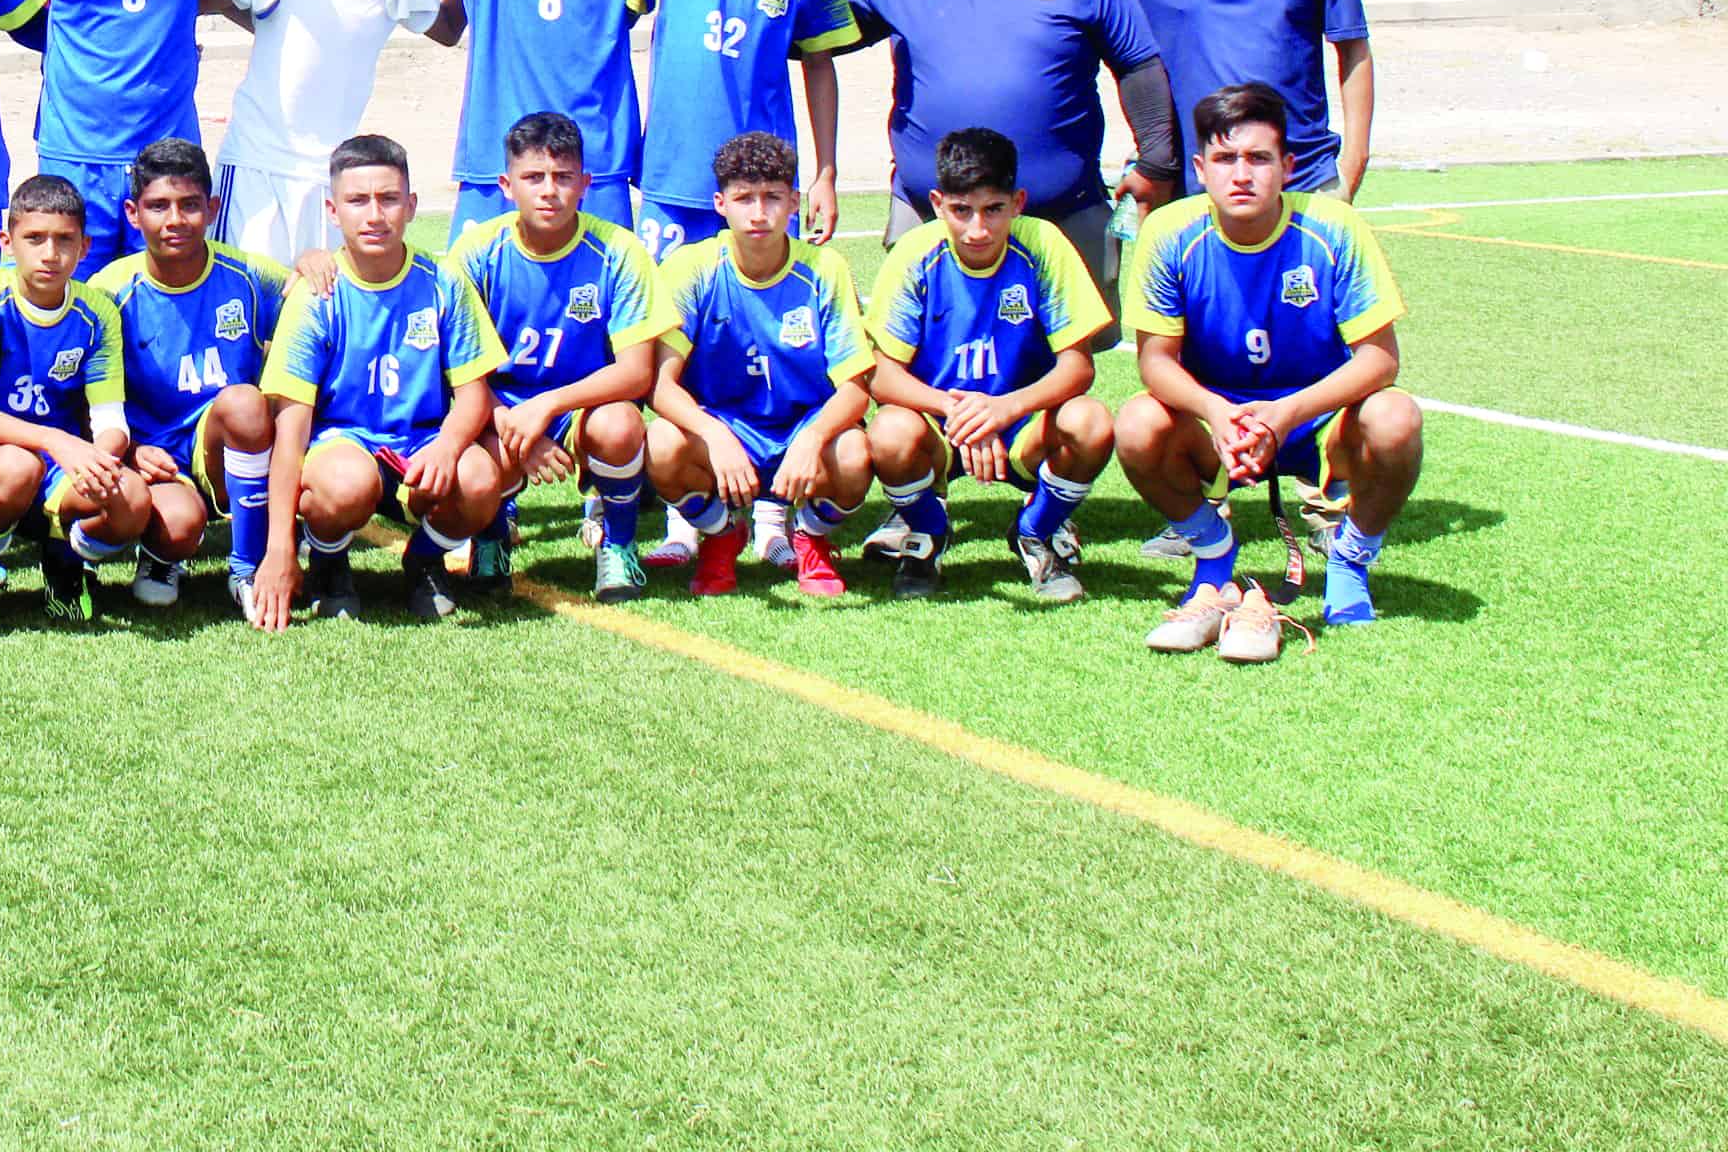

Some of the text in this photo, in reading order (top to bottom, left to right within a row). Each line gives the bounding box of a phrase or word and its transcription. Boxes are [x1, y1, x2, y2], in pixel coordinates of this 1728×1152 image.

[703, 10, 747, 58] 32
[513, 326, 563, 368] 27
[1245, 328, 1271, 364] 9
[177, 346, 228, 395] 44
[367, 353, 400, 397] 16
